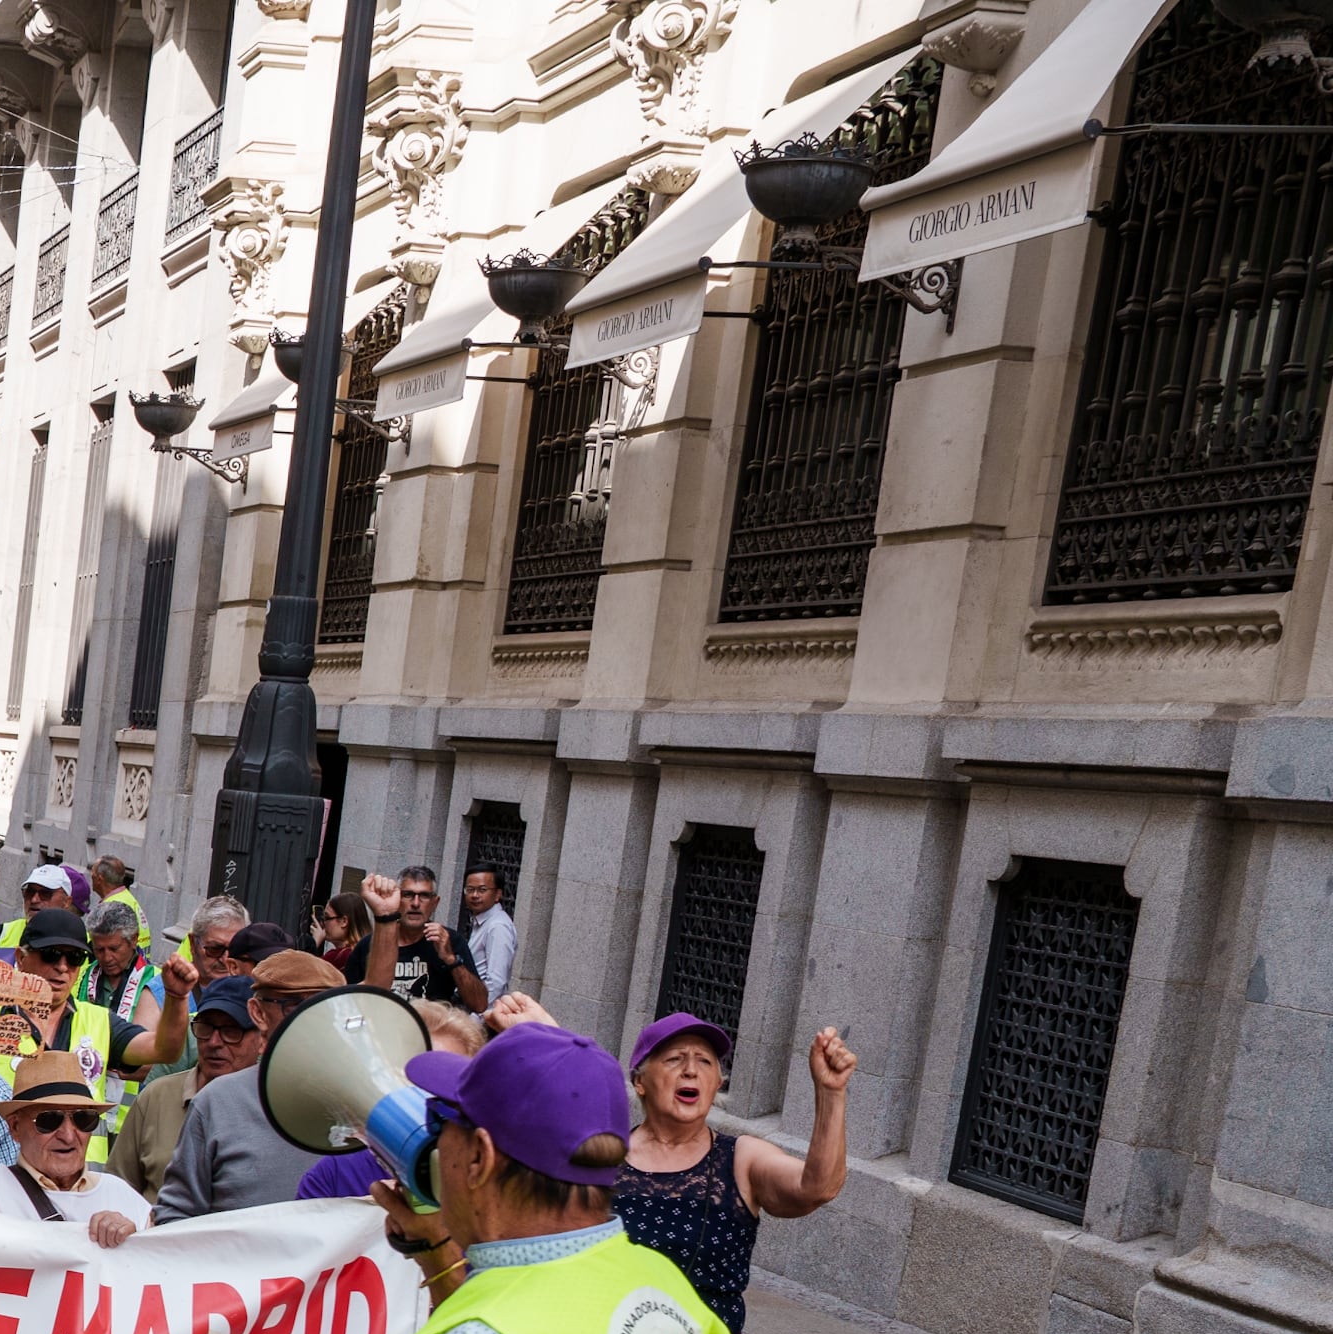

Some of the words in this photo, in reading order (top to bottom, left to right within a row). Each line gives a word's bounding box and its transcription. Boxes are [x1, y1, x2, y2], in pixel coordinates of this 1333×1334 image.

[909, 206, 971, 243] GIORGIO
[974, 182, 1037, 226] ARMANI
[597, 310, 635, 343] GIORGIO
[636, 299, 675, 332] ARMANI
[395, 379, 421, 401] GIORGIO
[421, 370, 446, 395] ARMANI
[231, 431, 251, 448] OMEGA
[21, 976, 44, 993] NO
